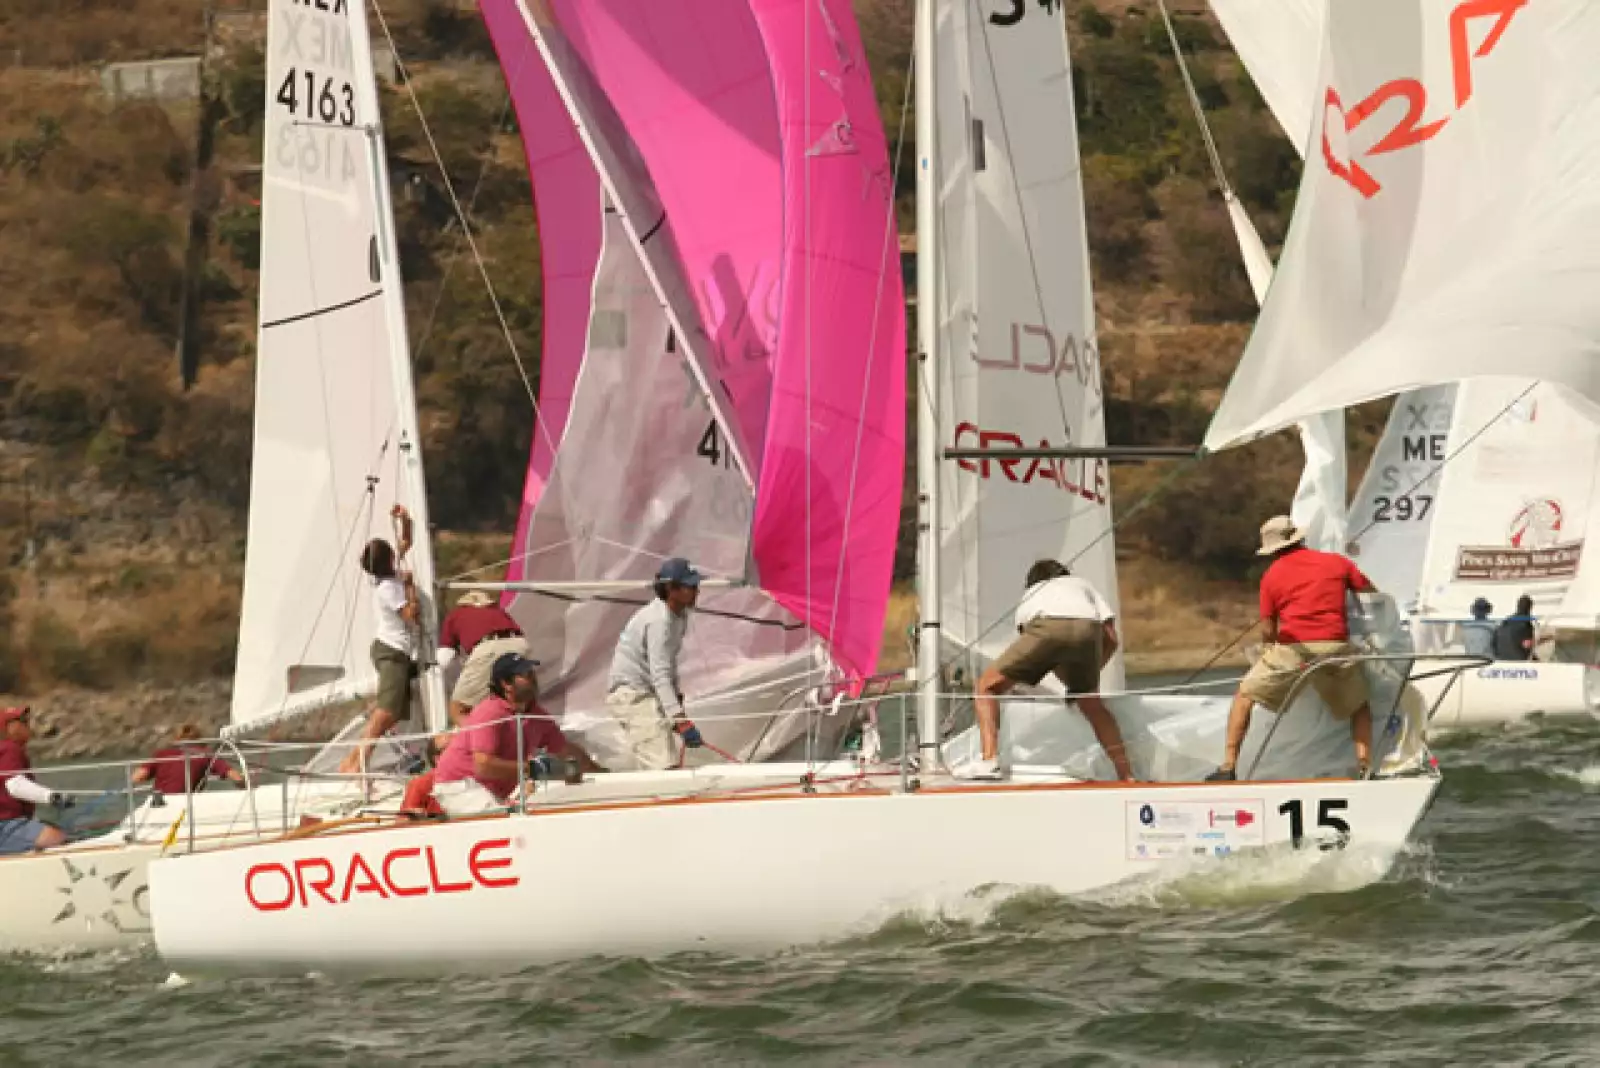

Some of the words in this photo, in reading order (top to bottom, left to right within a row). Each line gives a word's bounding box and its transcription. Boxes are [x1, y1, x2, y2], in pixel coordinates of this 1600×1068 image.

[277, 67, 355, 126] 4163
[1403, 435, 1446, 461] ME
[1374, 495, 1433, 521] 297
[1278, 799, 1350, 850] 15
[245, 838, 520, 911] ORACLE
